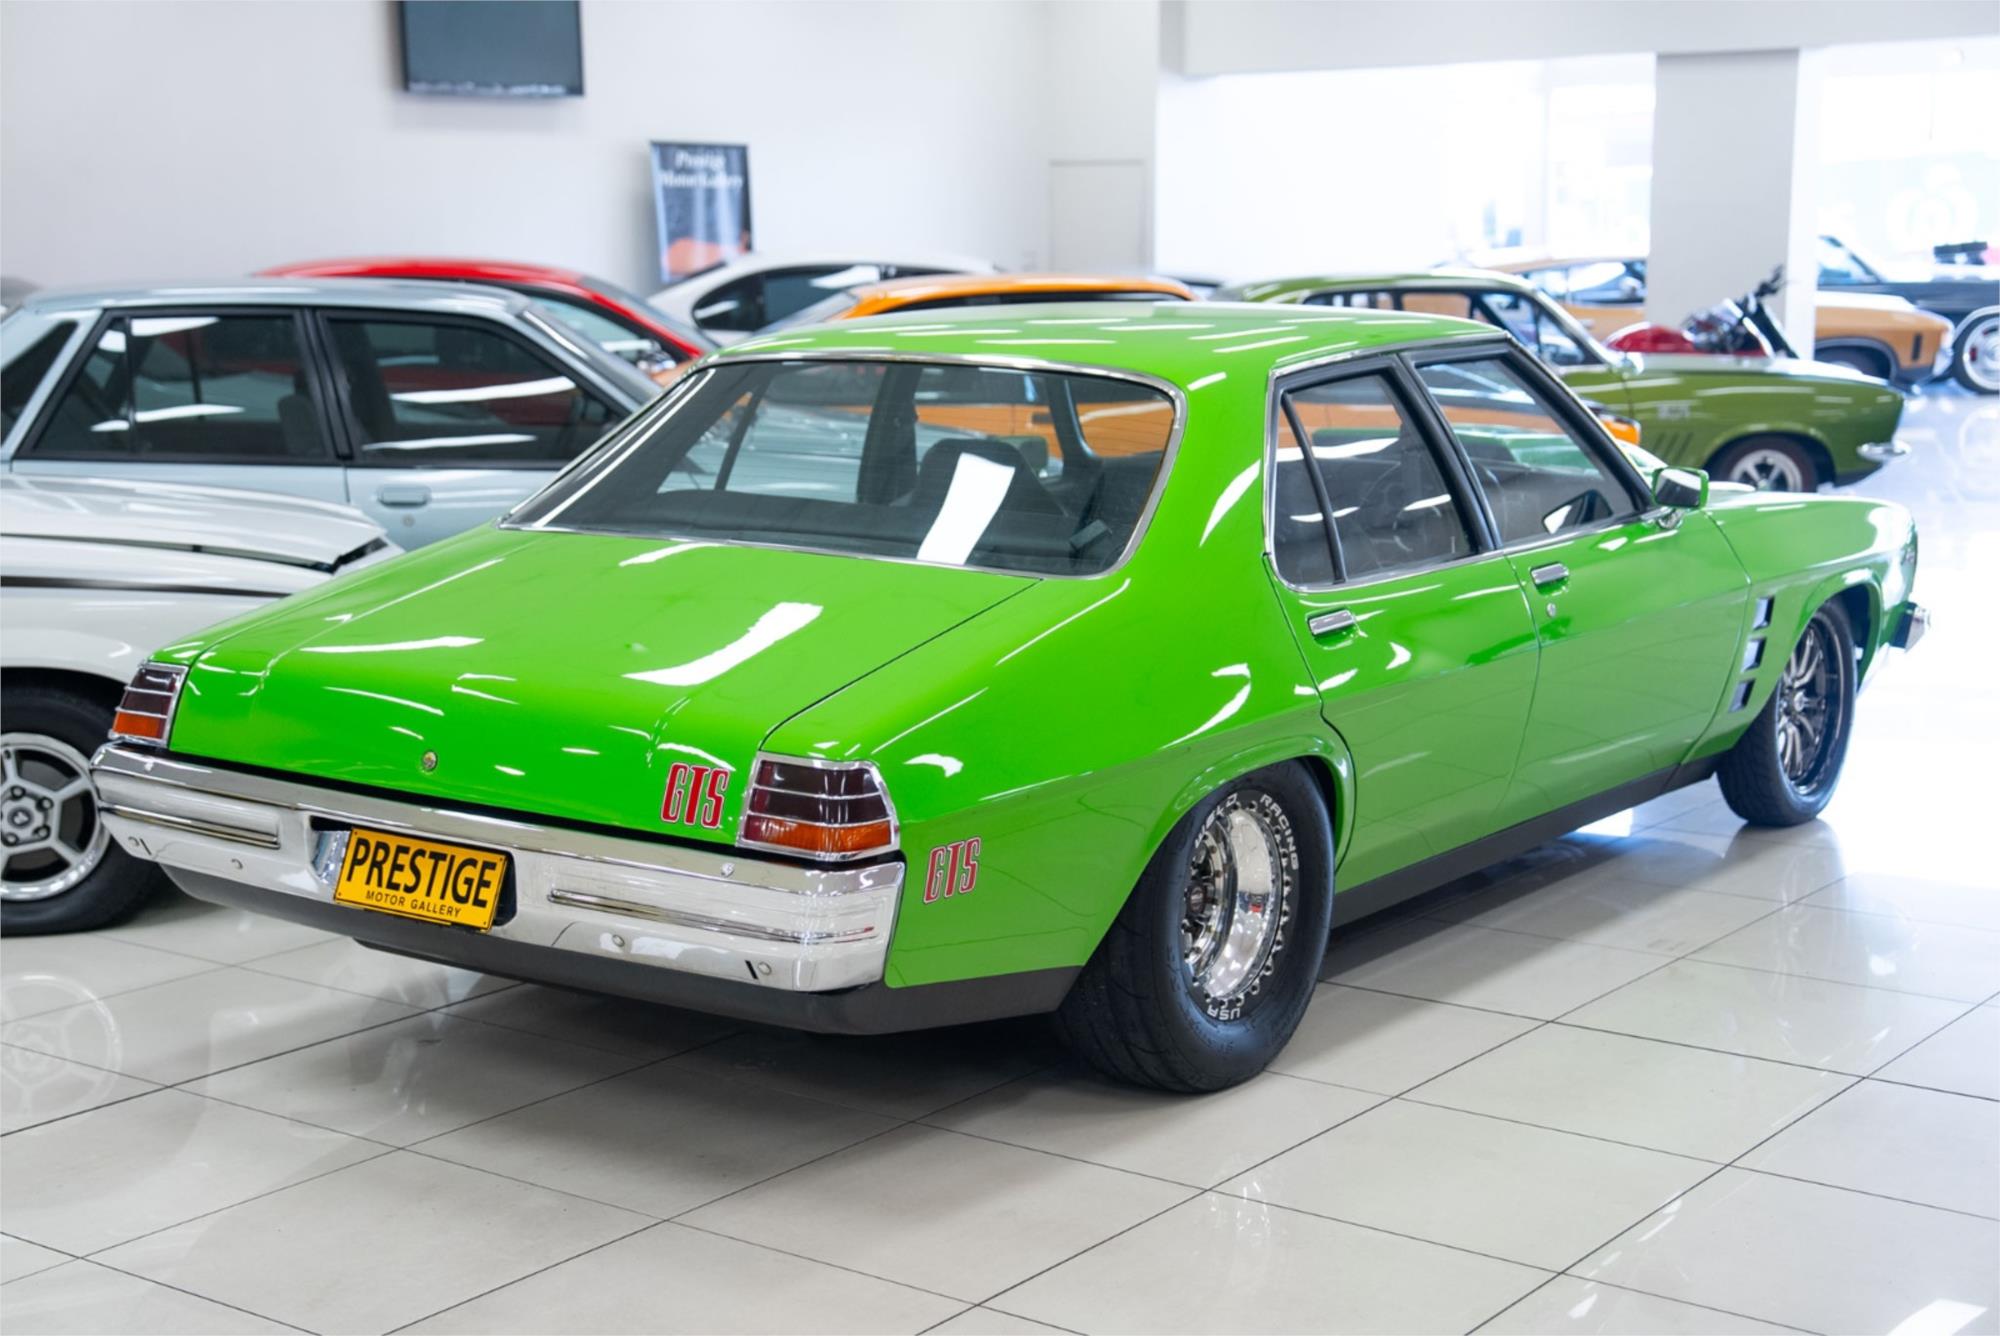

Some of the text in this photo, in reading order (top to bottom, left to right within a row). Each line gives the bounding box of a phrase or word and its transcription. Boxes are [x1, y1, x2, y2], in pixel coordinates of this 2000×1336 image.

[660, 762, 730, 829] GTS
[1260, 794, 1299, 870] RACING
[345, 837, 497, 908] PRESTIGE
[366, 890, 462, 918] MOTOR GALLERY
[922, 837, 982, 904] GTS
[1206, 1004, 1241, 1020] USA
